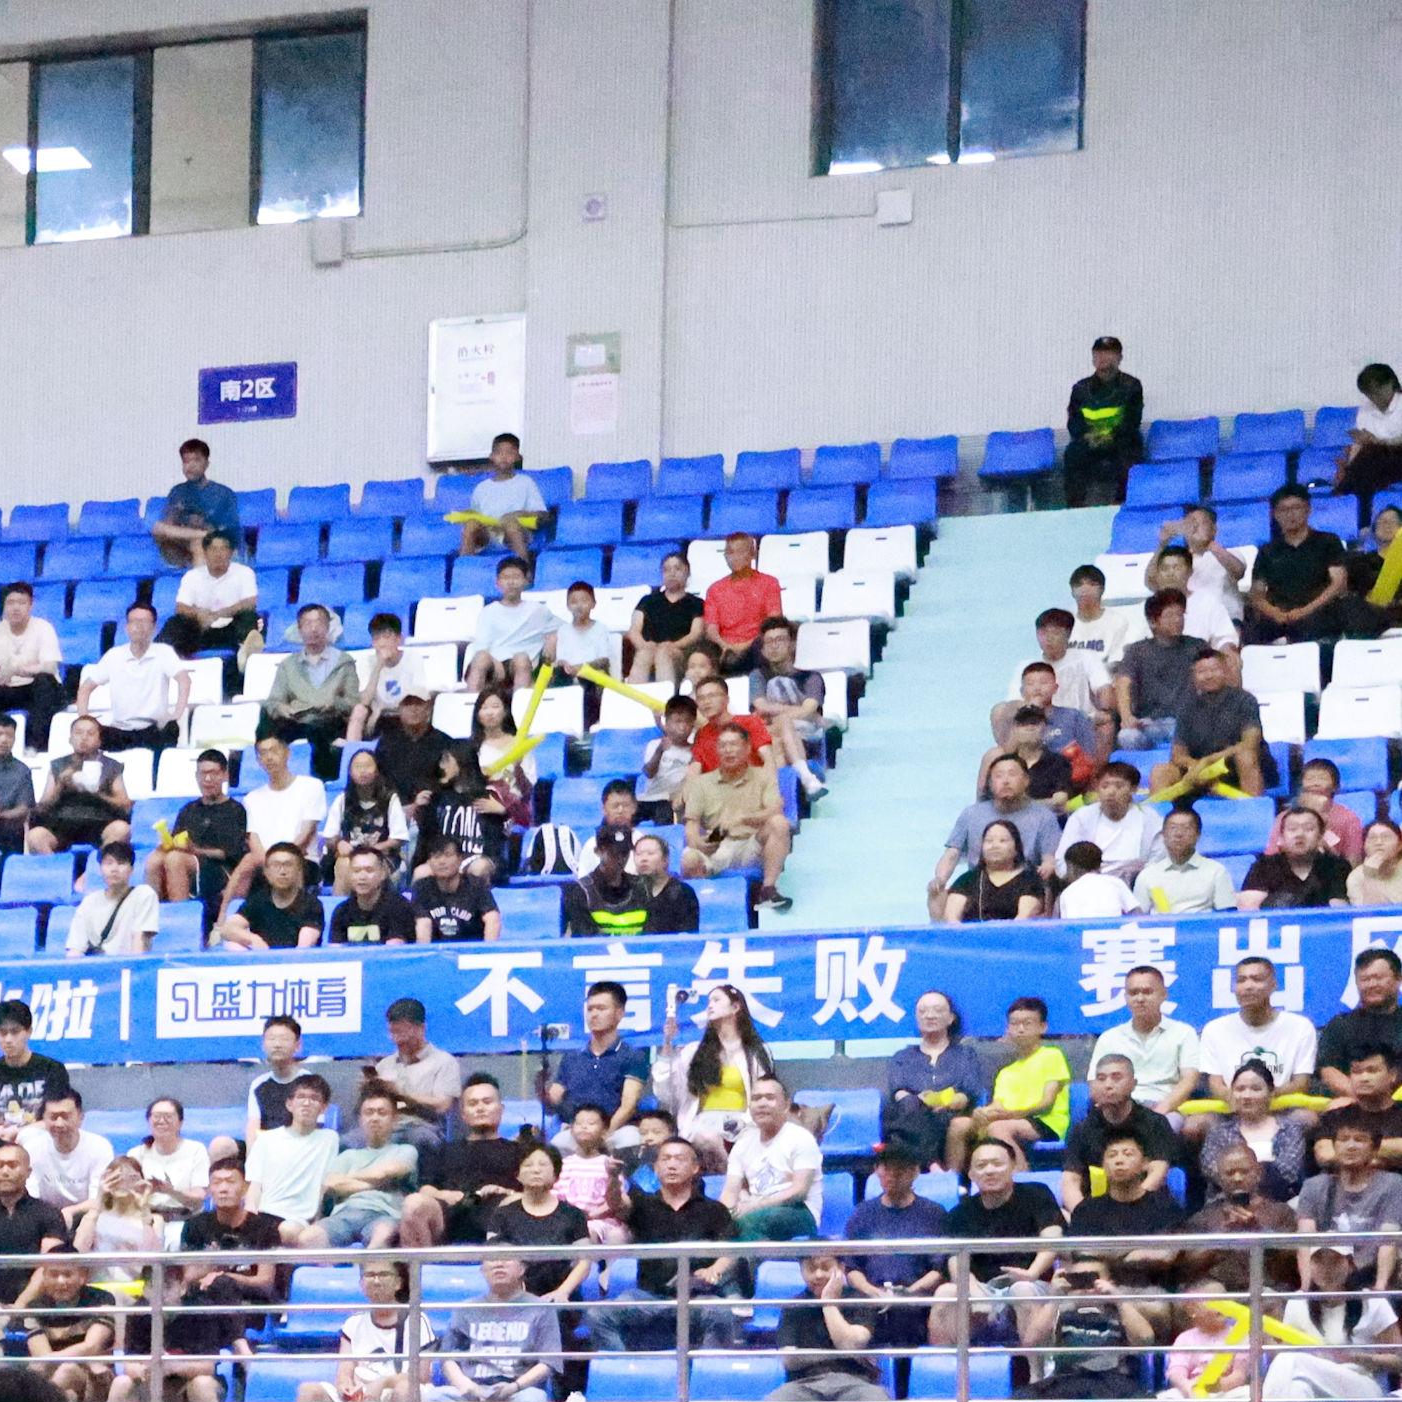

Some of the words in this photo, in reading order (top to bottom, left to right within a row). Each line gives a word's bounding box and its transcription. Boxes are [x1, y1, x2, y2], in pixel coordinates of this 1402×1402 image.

[220, 377, 276, 402] 南2区
[456, 936, 907, 1036] 不言失败
